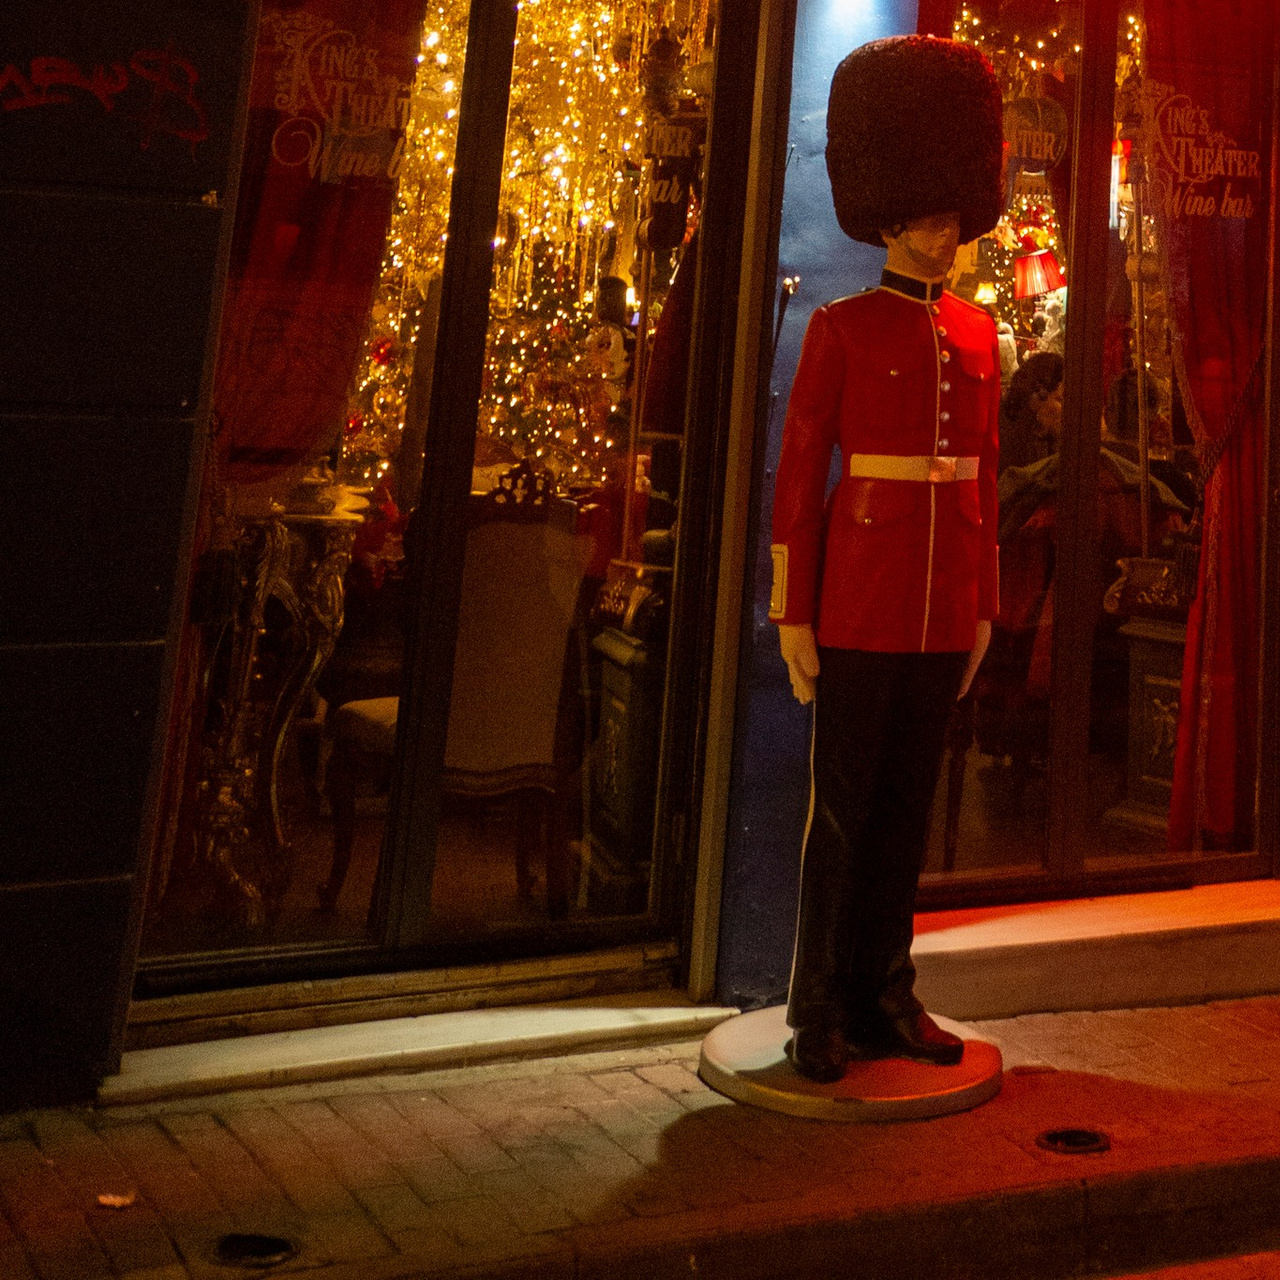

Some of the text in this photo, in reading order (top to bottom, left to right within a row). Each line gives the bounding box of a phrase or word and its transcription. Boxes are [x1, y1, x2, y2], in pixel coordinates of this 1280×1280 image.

[324, 79, 413, 137] THEAT
[271, 116, 381, 184] Wine
[1171, 136, 1261, 183] THEATER
[1221, 182, 1255, 218] bar
